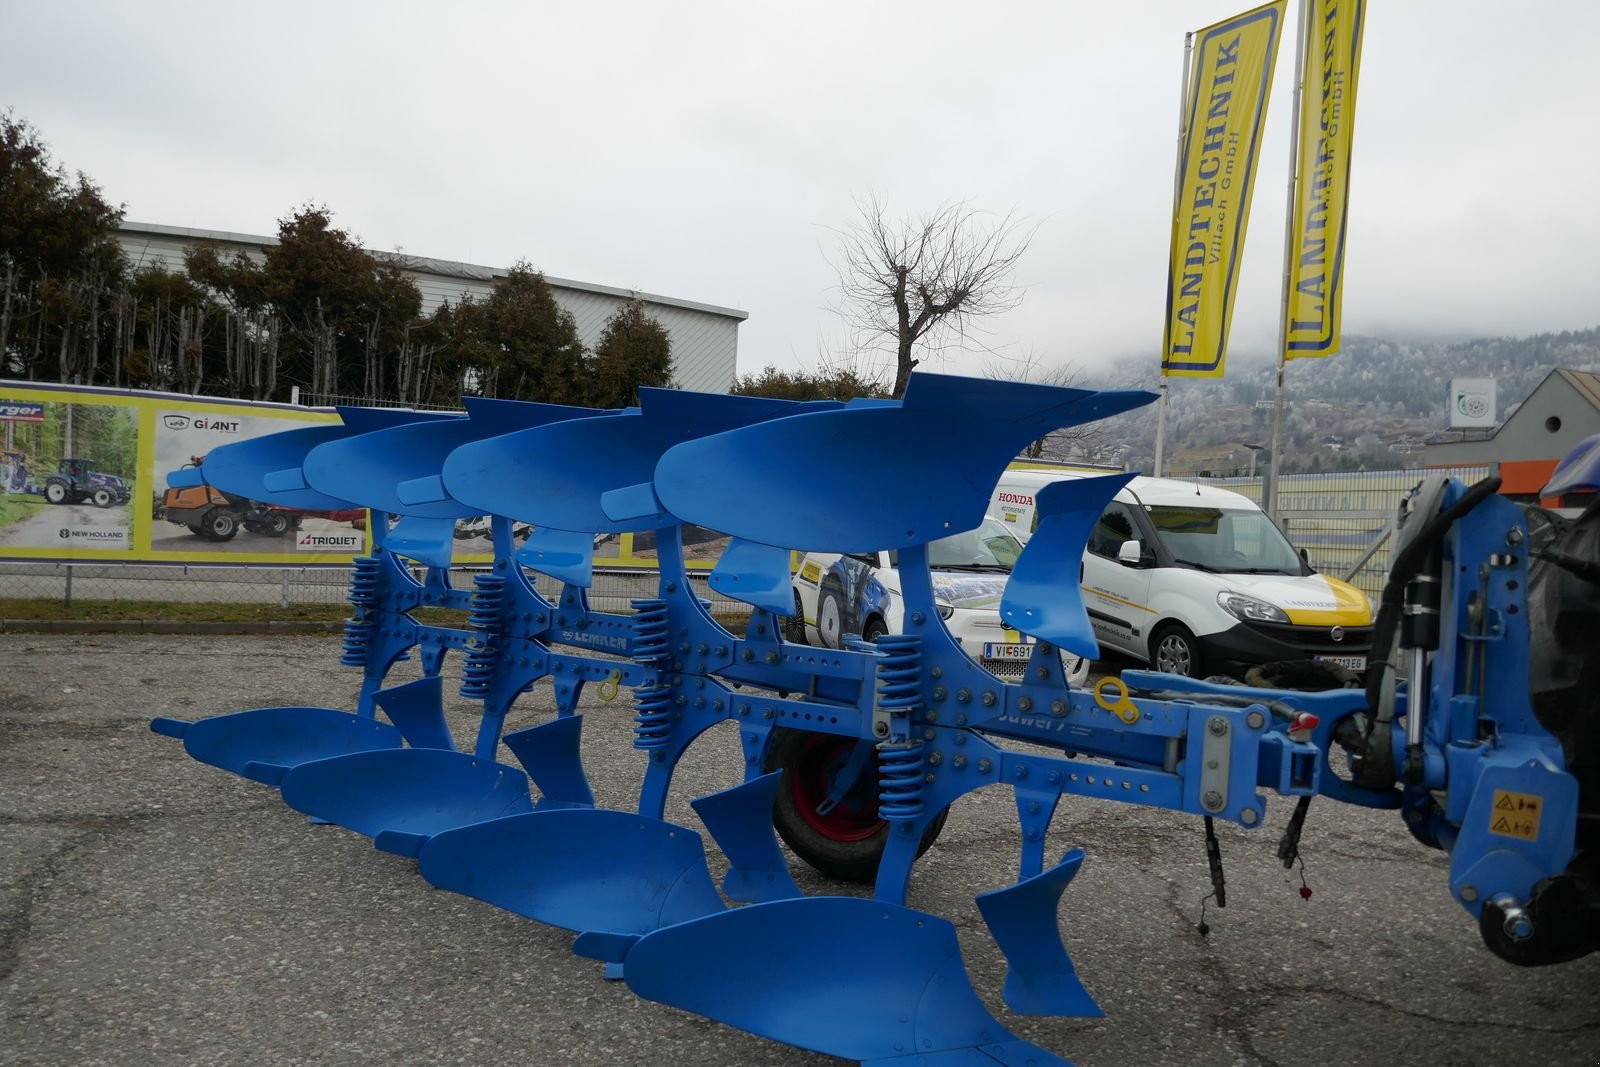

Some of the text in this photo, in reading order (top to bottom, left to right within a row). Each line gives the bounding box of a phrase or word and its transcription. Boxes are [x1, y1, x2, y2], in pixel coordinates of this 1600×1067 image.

[1329, 71, 1345, 138] GmbH
[1172, 32, 1242, 356] LANDTECHNIK
[1208, 131, 1240, 265] Villach GmbH
[998, 492, 1034, 506] HONDA
[71, 530, 124, 539] NEW HOLLAND
[574, 632, 627, 650] LEMKEN
